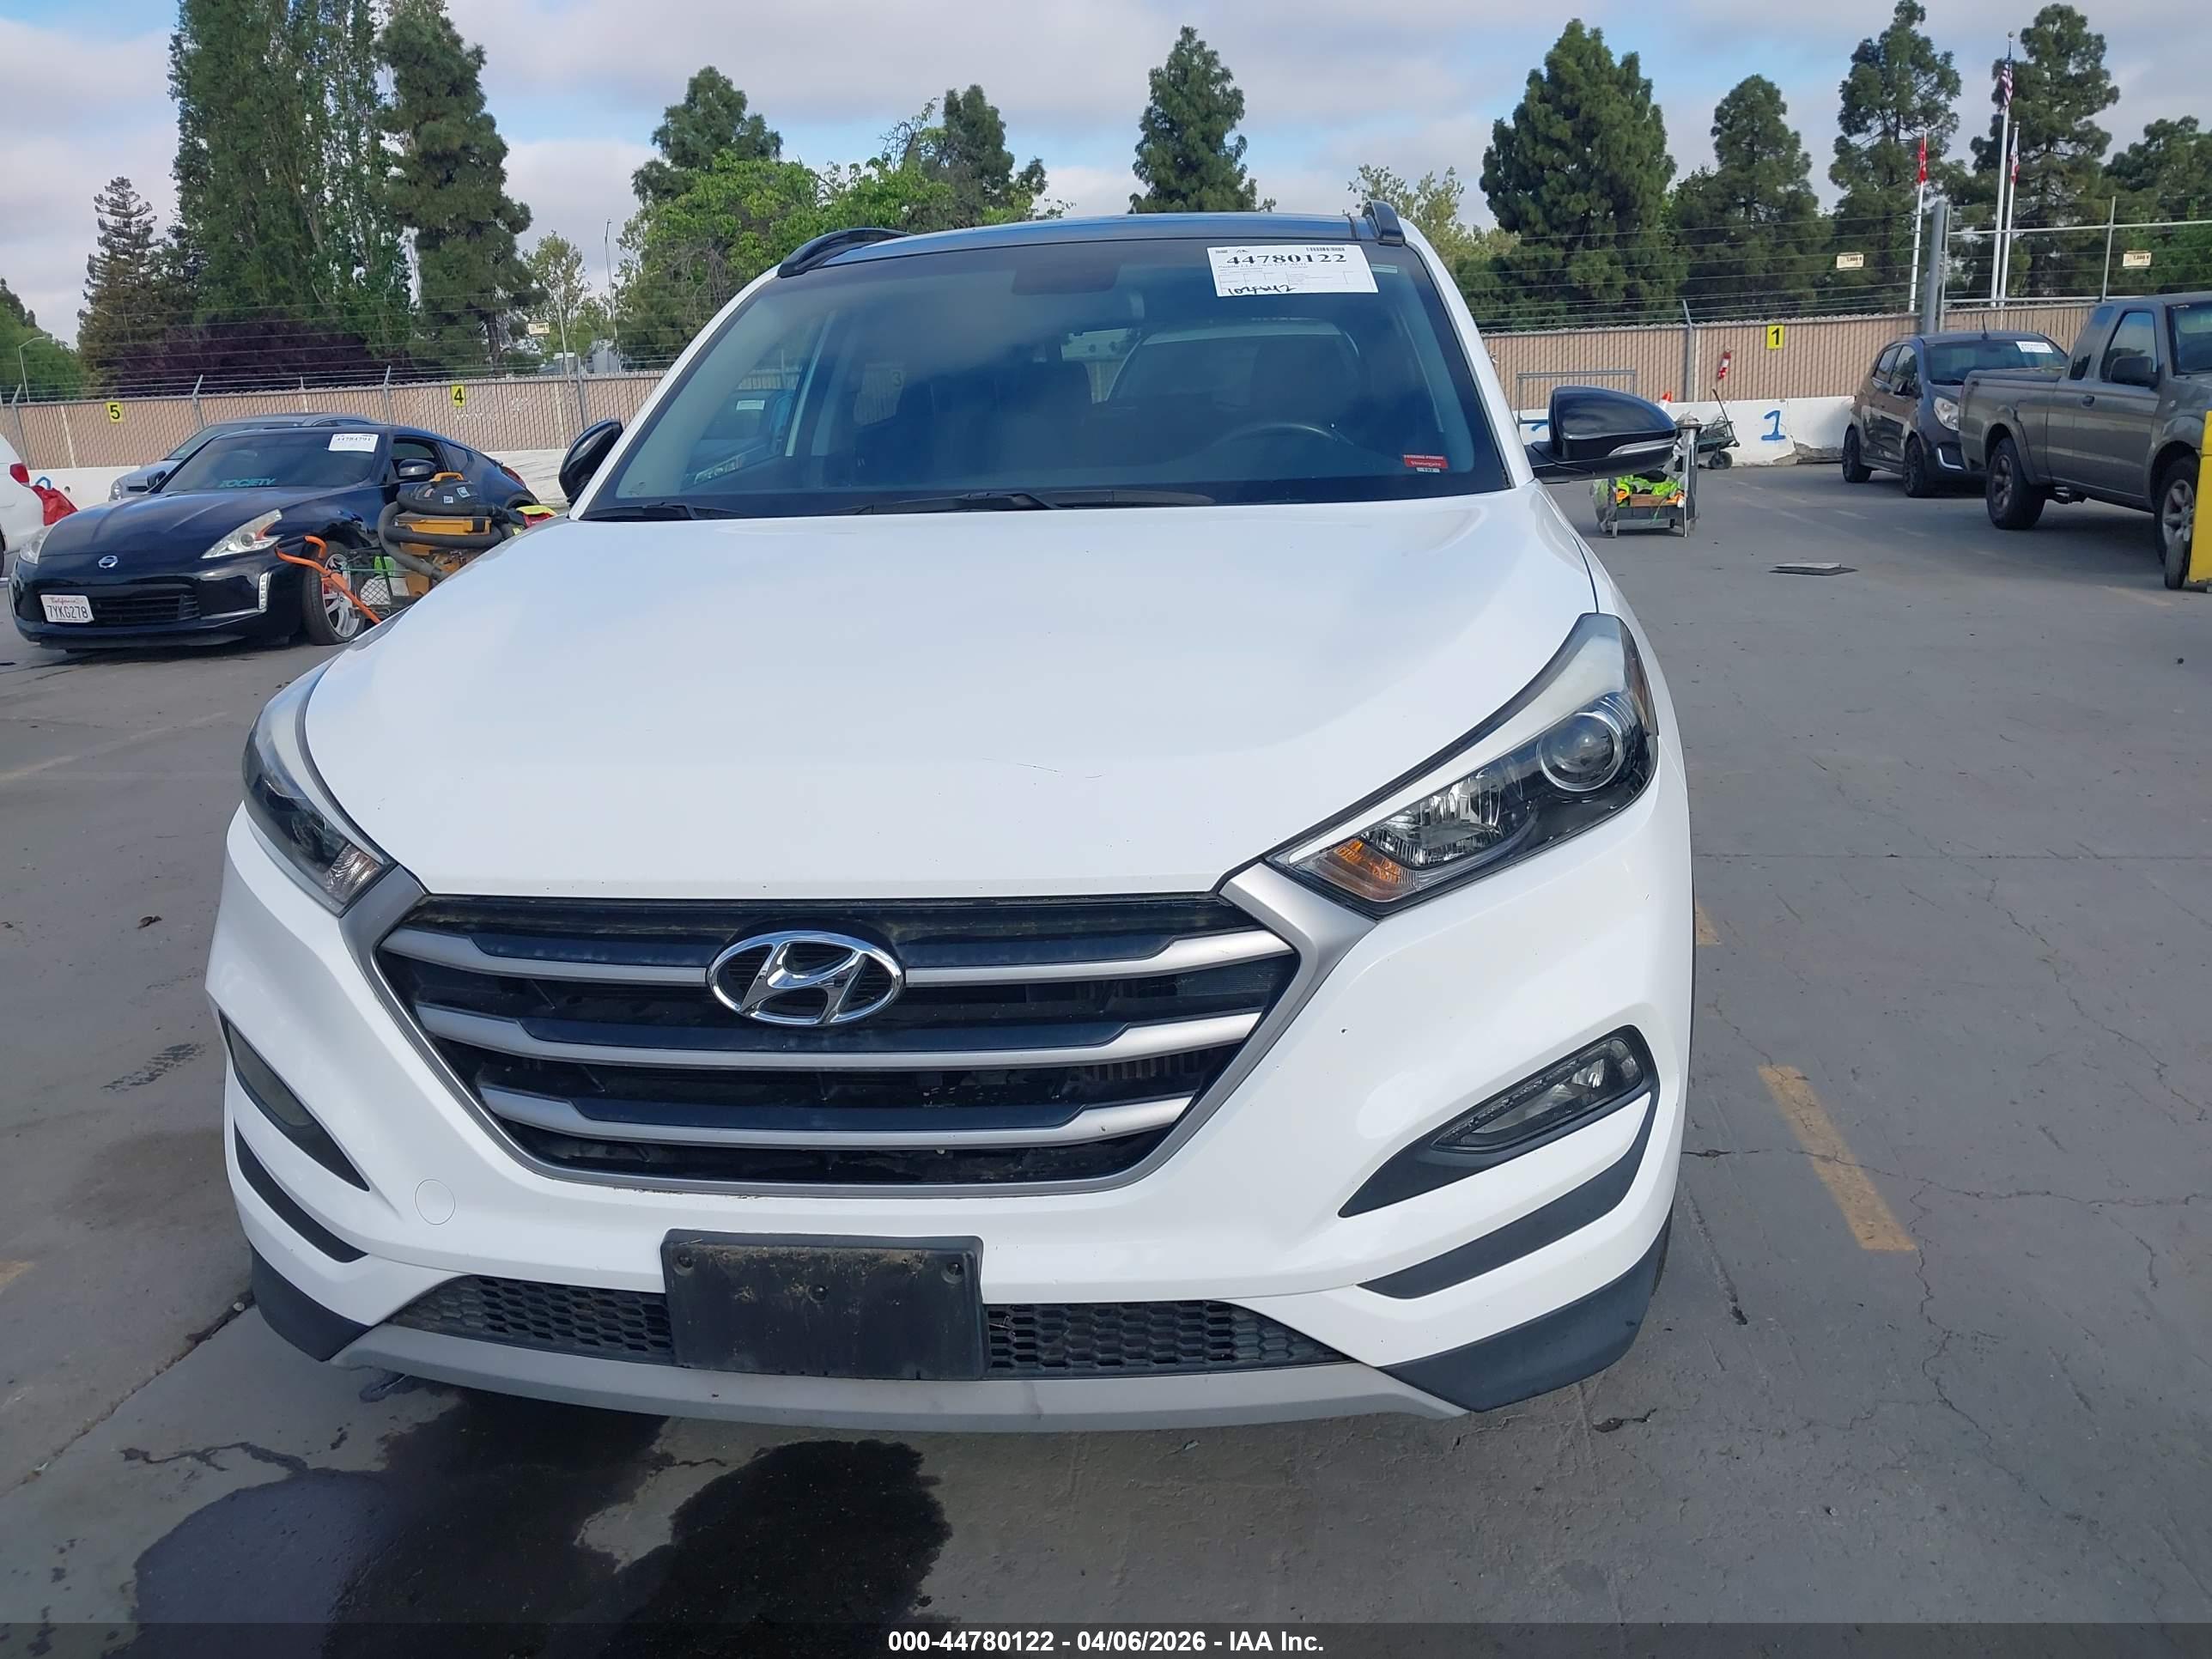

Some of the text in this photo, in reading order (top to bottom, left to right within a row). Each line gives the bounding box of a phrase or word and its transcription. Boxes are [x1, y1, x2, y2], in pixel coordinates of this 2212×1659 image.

[1226, 254, 1347, 265] 44780122
[1771, 327, 1780, 345] 1
[892, 371, 902, 386] 3
[453, 386, 464, 404] 4
[109, 404, 120, 420] 5
[1760, 410, 1786, 441] 1
[46, 605, 88, 619] 7YKG278
